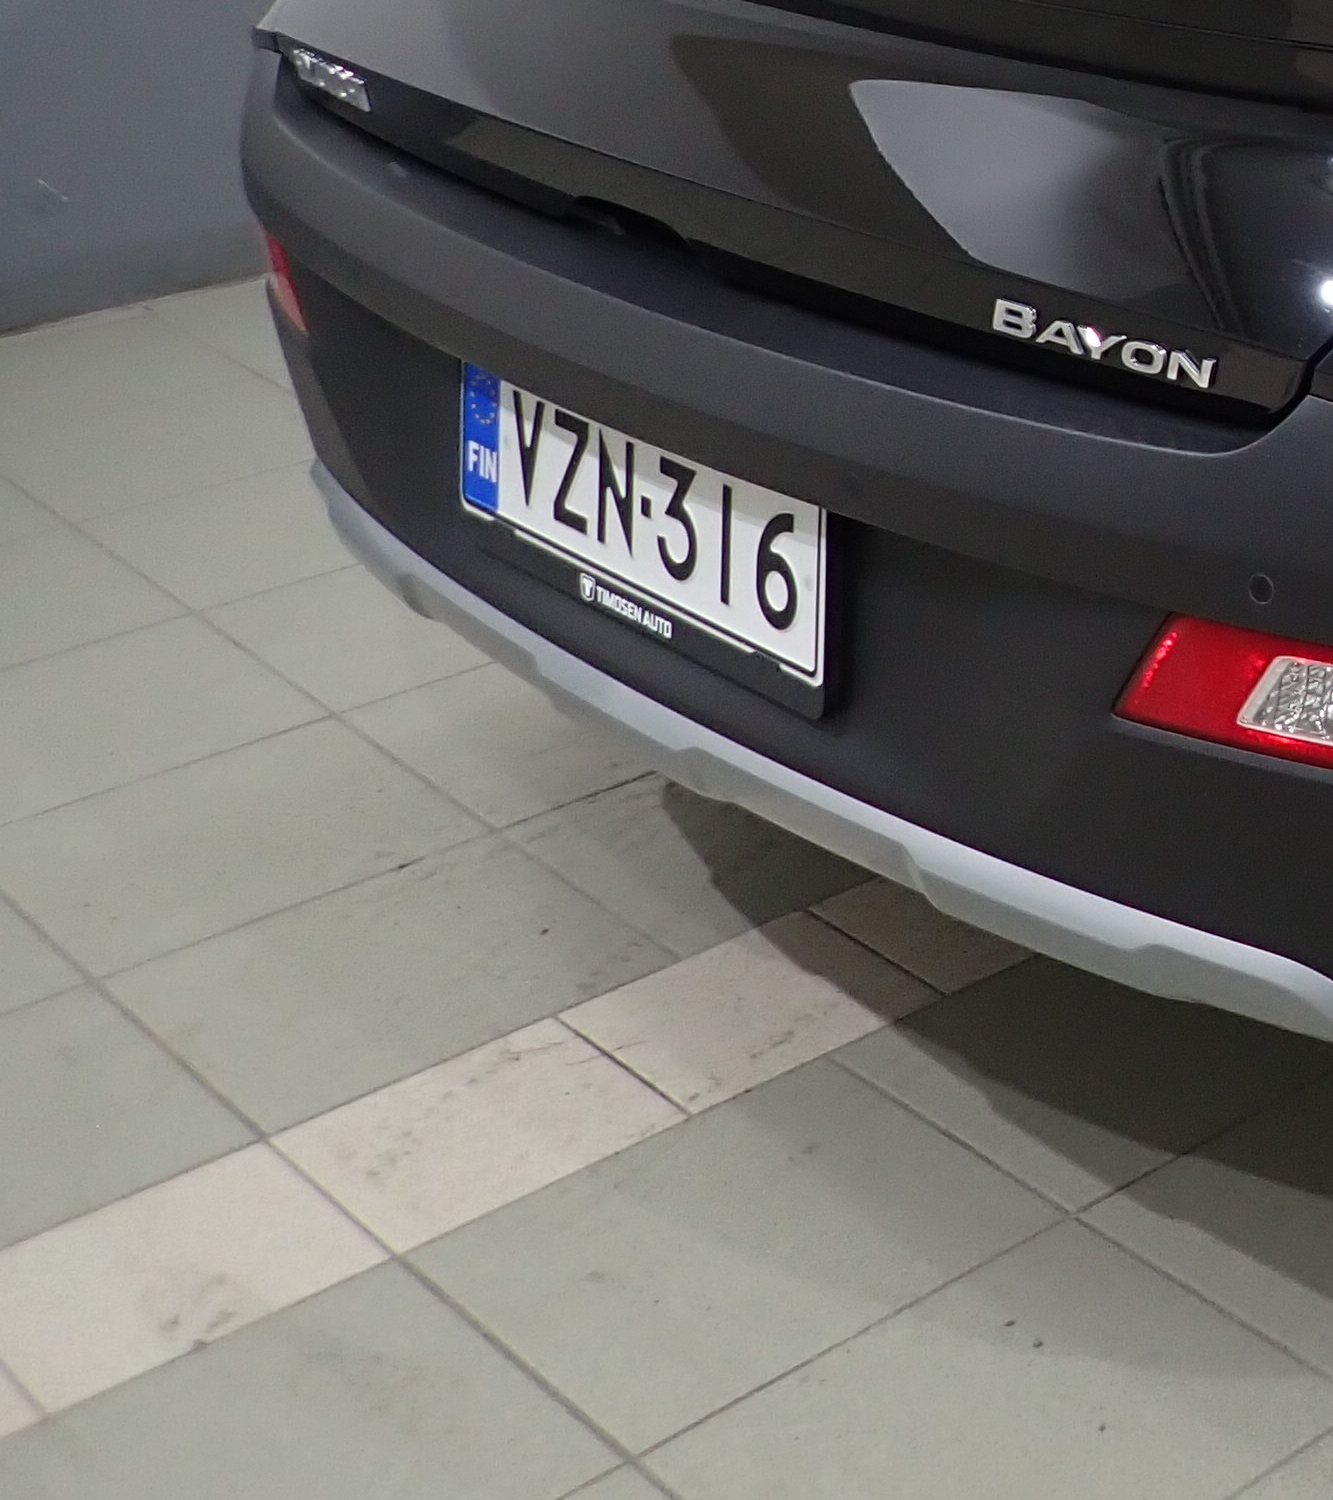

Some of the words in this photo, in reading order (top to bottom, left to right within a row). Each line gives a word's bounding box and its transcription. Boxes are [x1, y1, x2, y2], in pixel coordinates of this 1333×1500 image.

[992, 298, 1218, 389] BAYON
[468, 439, 497, 483] FIN
[513, 389, 799, 632] VZN-316
[596, 584, 643, 624] TIMOSEN
[641, 610, 673, 639] AUTO
